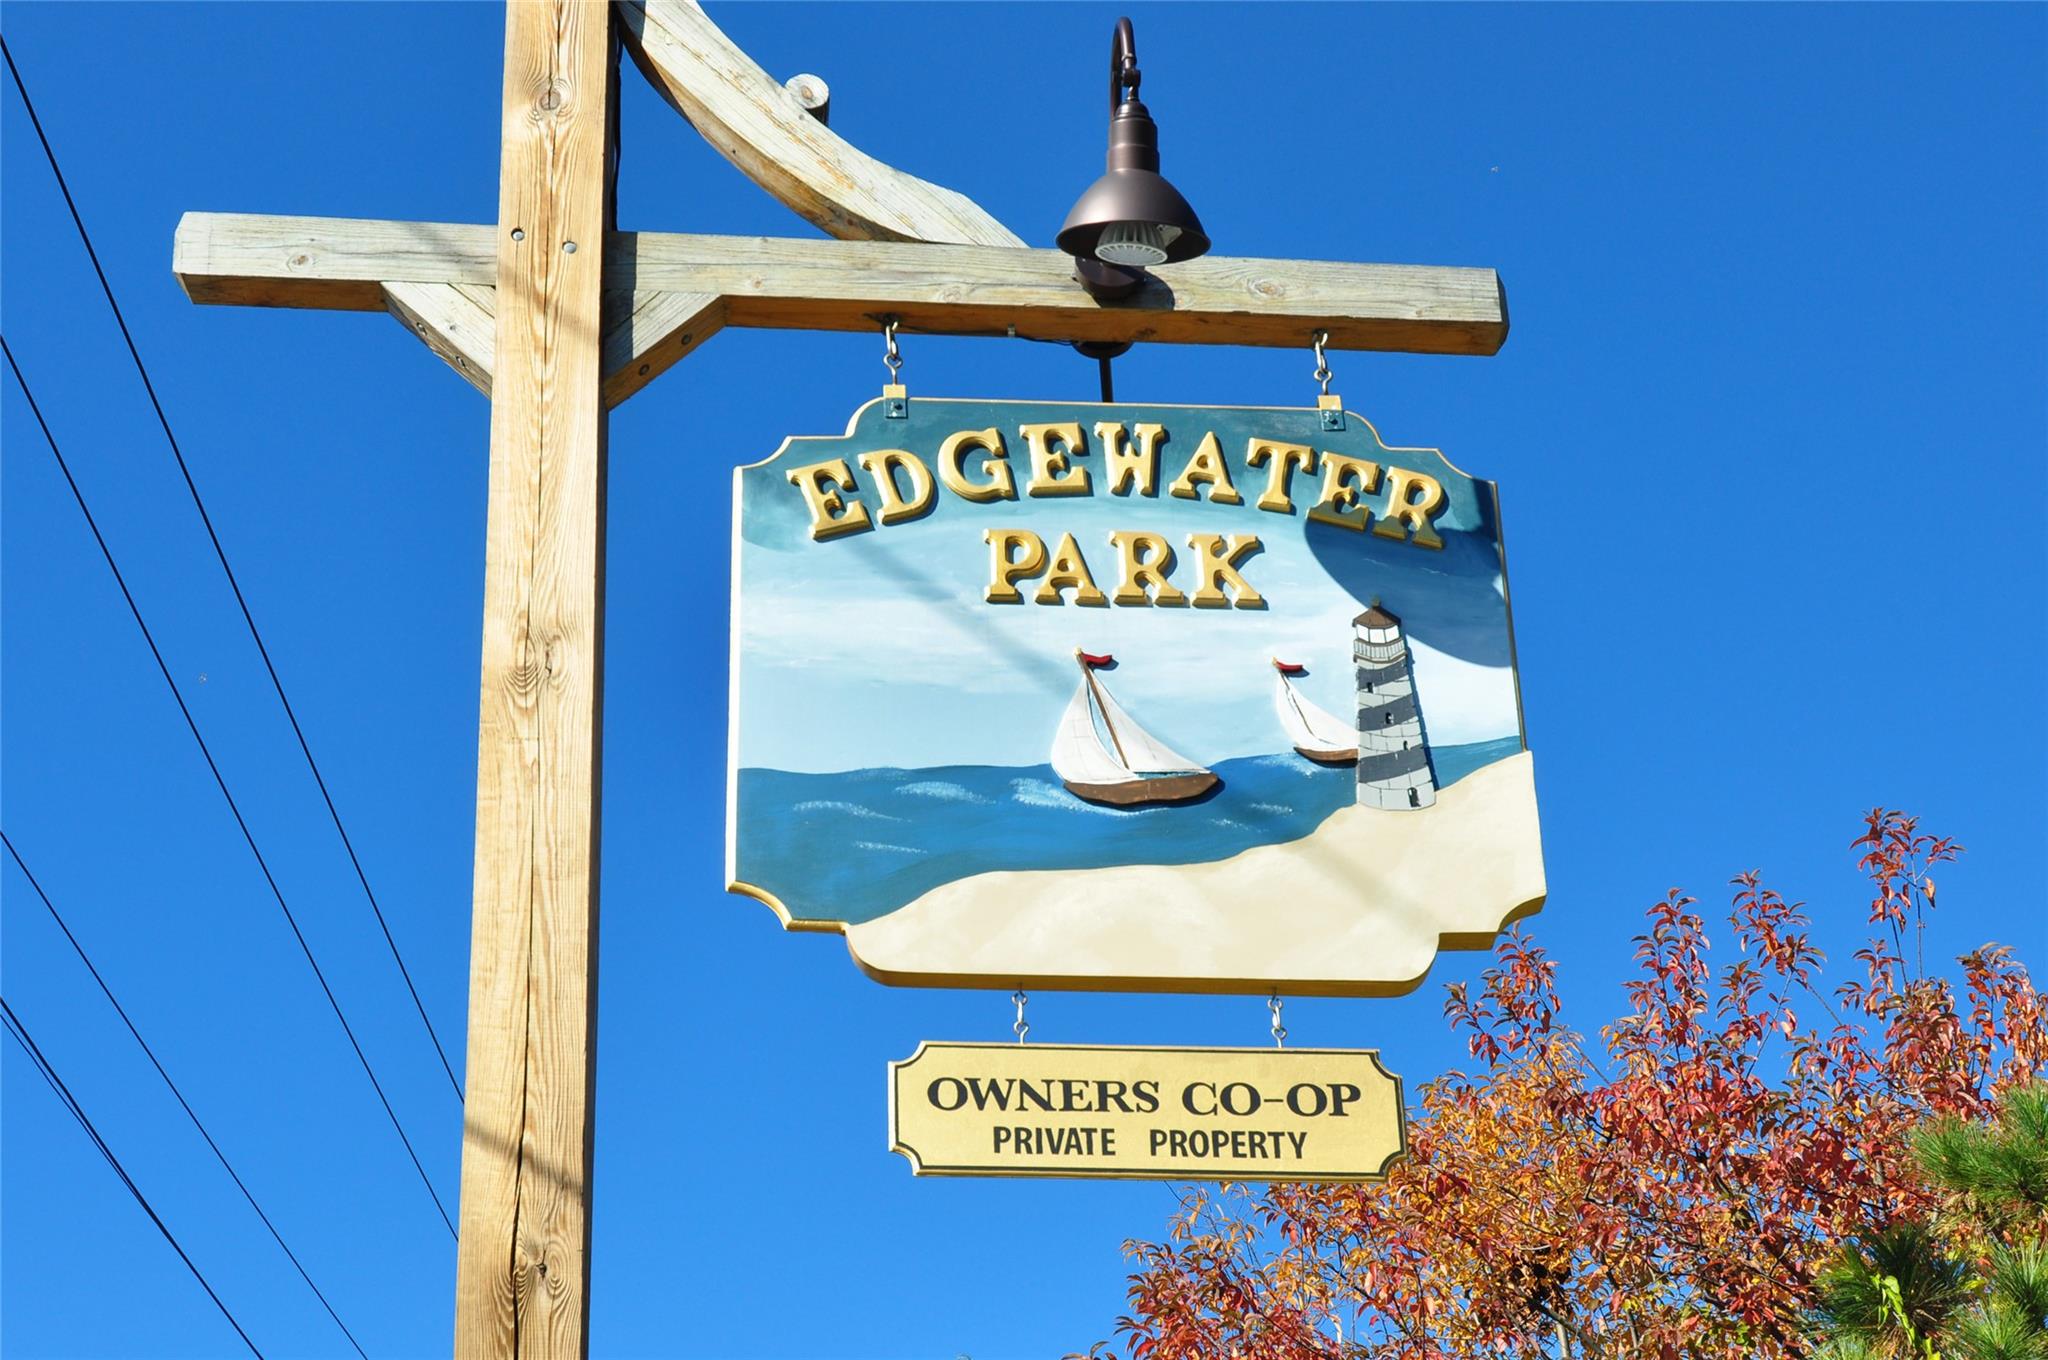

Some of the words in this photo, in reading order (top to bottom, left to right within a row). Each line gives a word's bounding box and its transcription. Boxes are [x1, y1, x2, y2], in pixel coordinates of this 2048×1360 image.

[786, 421, 1446, 549] EDGEWATER
[983, 528, 1266, 608] PARK
[927, 1077, 1160, 1114] OWNERS
[1181, 1082, 1361, 1117] CO-OP
[993, 1126, 1116, 1156] PRIVATE
[1150, 1129, 1308, 1159] PROPERTY
